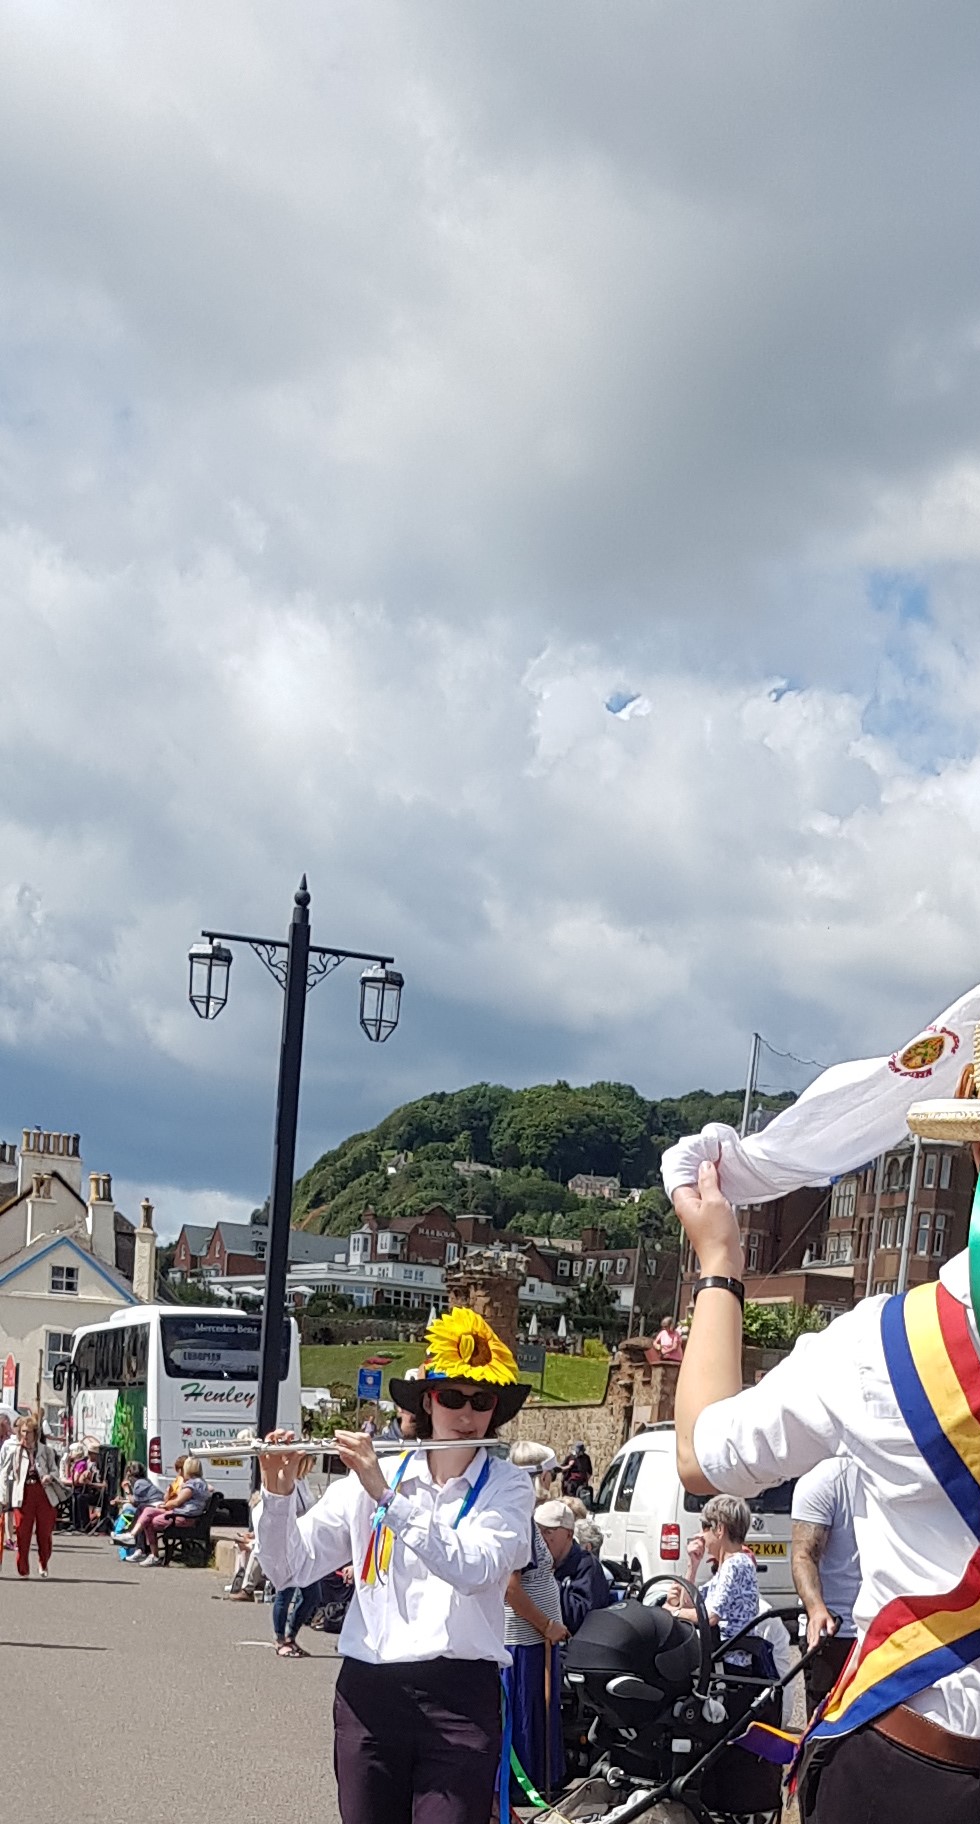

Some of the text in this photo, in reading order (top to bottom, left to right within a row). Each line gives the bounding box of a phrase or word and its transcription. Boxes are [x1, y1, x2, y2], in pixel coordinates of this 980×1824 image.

[180, 1382, 256, 1408] Henley
[195, 1427, 226, 1437] South
[763, 1543, 785, 1555] KXA
